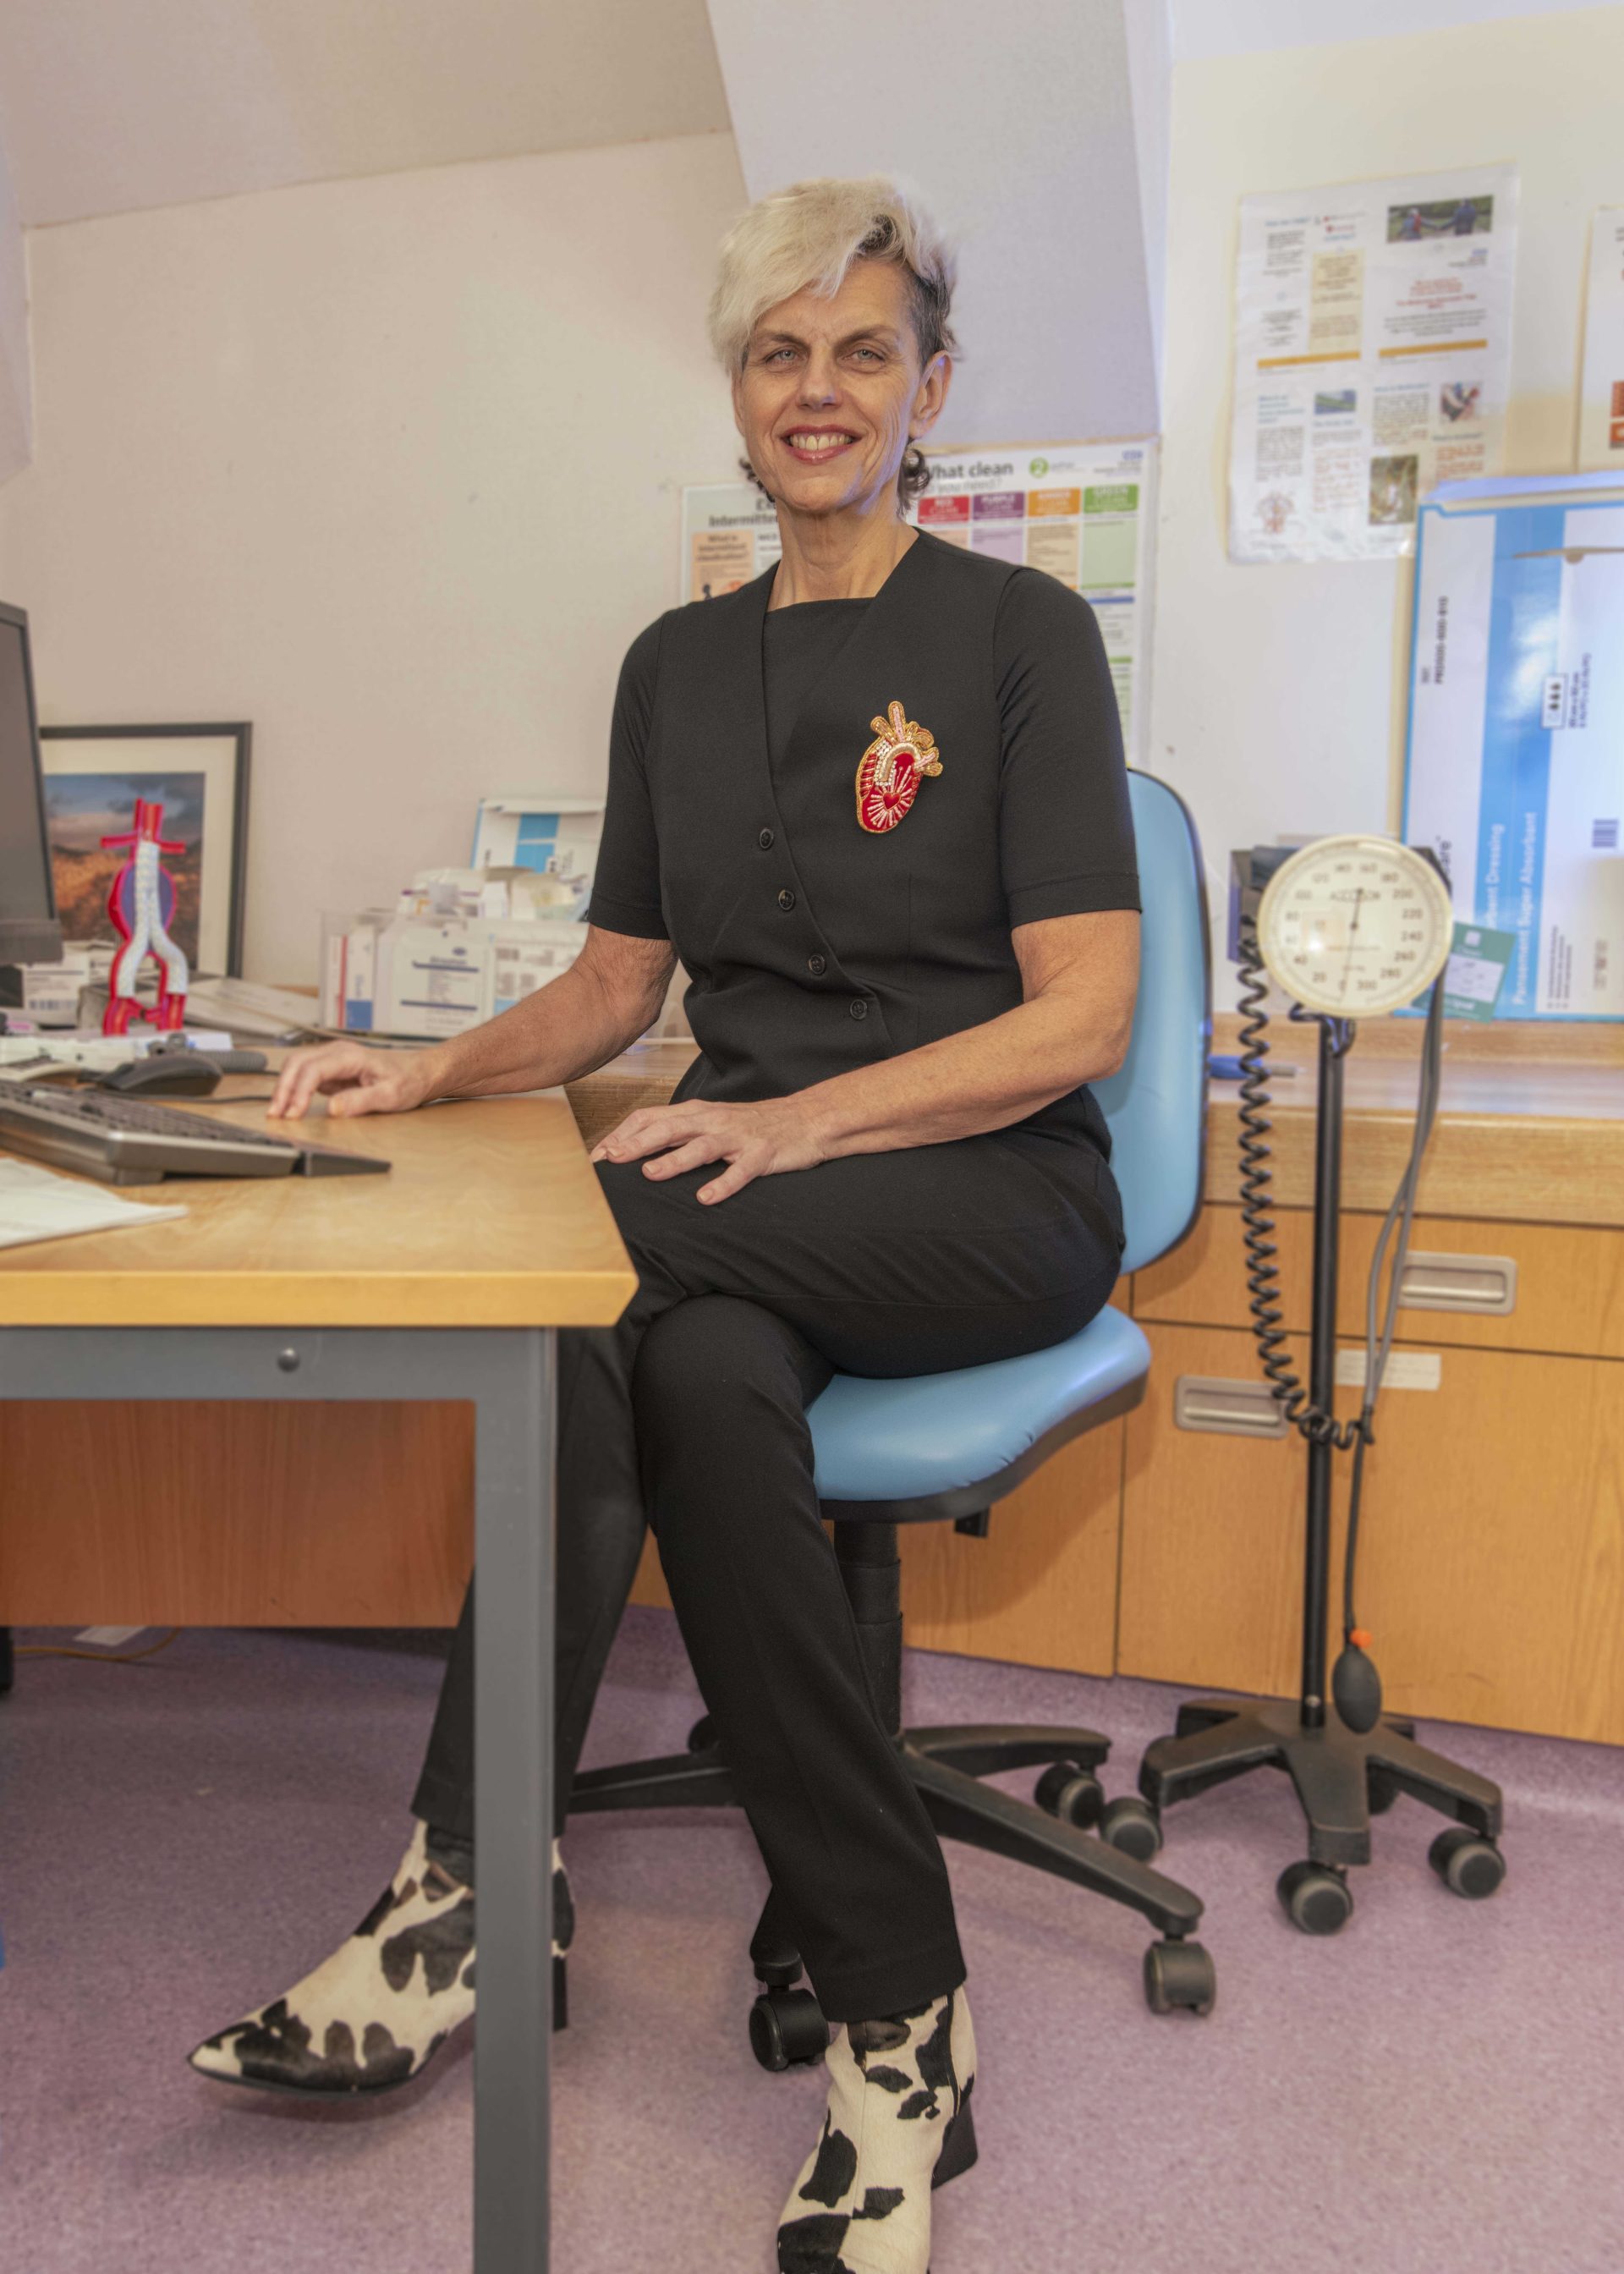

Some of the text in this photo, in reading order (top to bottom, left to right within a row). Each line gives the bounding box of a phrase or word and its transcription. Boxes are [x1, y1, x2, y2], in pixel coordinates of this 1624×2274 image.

[968, 461, 1014, 476] clean
[938, 482, 961, 492] you
[963, 478, 1002, 490] need?
[709, 513, 778, 528] Intermitte
[1485, 824, 1505, 884] Dressing
[1392, 888, 1413, 899] 200
[1517, 887, 1533, 926] Super
[1402, 909, 1423, 920] 220
[1402, 931, 1423, 942] 240
[1293, 954, 1308, 965] 40
[1394, 950, 1415, 962] 260
[1312, 971, 1327, 982] 20
[1380, 967, 1402, 979] 280
[1357, 980, 1377, 991] 300
